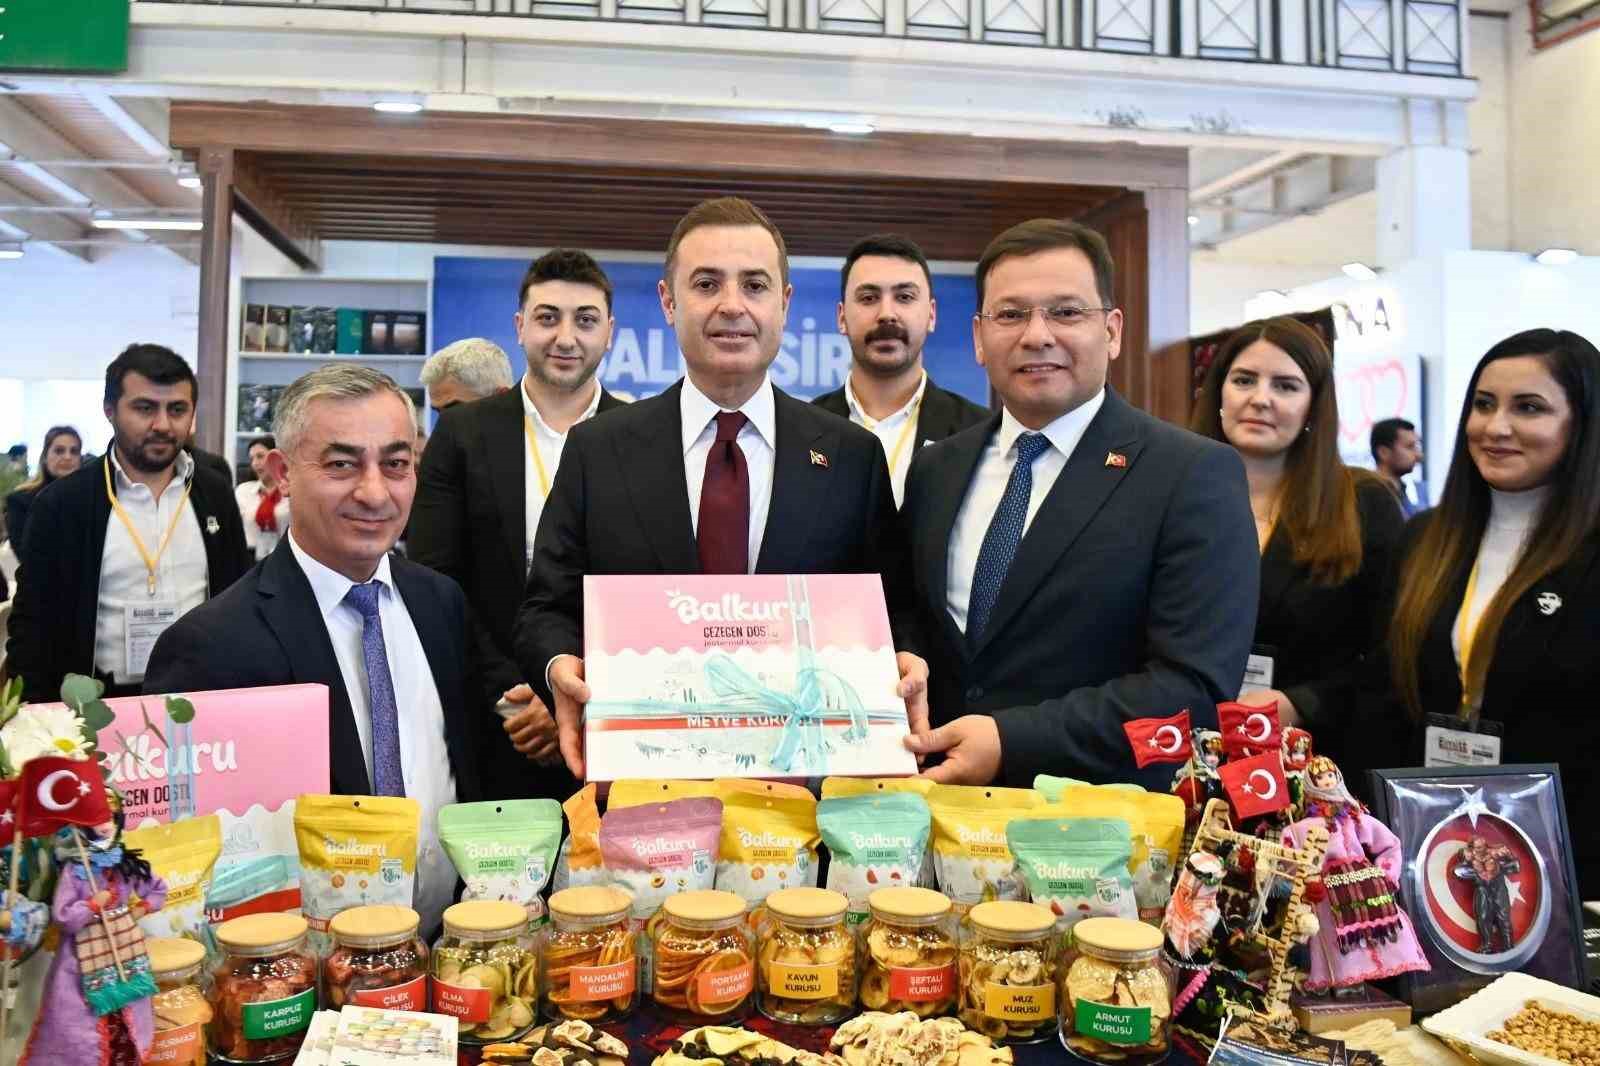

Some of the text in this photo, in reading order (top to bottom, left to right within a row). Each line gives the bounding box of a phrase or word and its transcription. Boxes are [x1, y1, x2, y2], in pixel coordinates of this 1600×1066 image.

[746, 625, 778, 638] DOS
[687, 714, 741, 729] MEYVE
[101, 735, 238, 783] alkuru
[786, 973, 819, 983] KAVUN
[588, 982, 624, 994] KURUSU
[784, 983, 822, 992] KURUSU
[909, 985, 943, 996] KURUSU
[442, 991, 464, 1003] ELMA
[1012, 995, 1033, 1003] MUZ
[263, 1003, 302, 1018] KARPUZ
[438, 1002, 469, 1015] KURUSU
[1003, 1005, 1040, 1014] KURUSU
[263, 1015, 302, 1031] KURUSU
[1095, 1013, 1131, 1024] ARMUT
[1092, 1022, 1133, 1035] KURUSU
